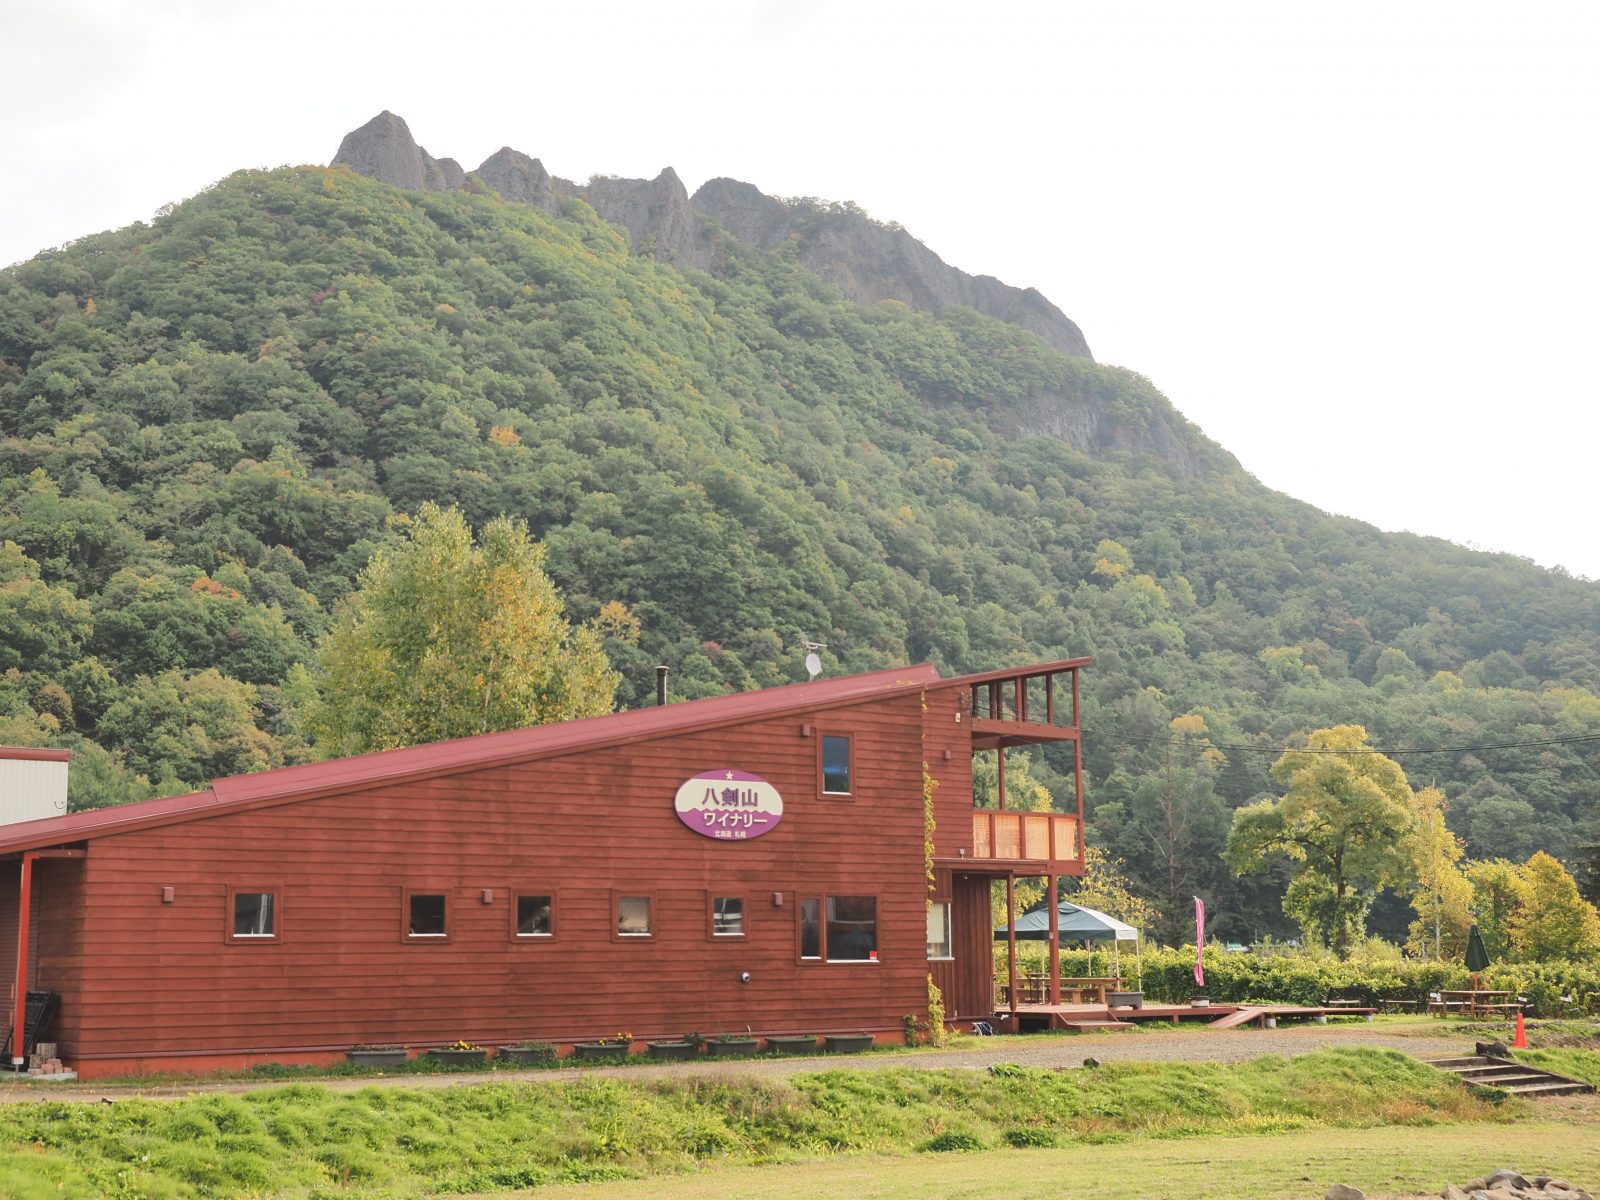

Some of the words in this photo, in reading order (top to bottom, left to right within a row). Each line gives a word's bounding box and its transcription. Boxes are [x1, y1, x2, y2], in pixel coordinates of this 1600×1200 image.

[702, 787, 758, 807] 八剣山
[704, 812, 768, 828] ワイナリー
